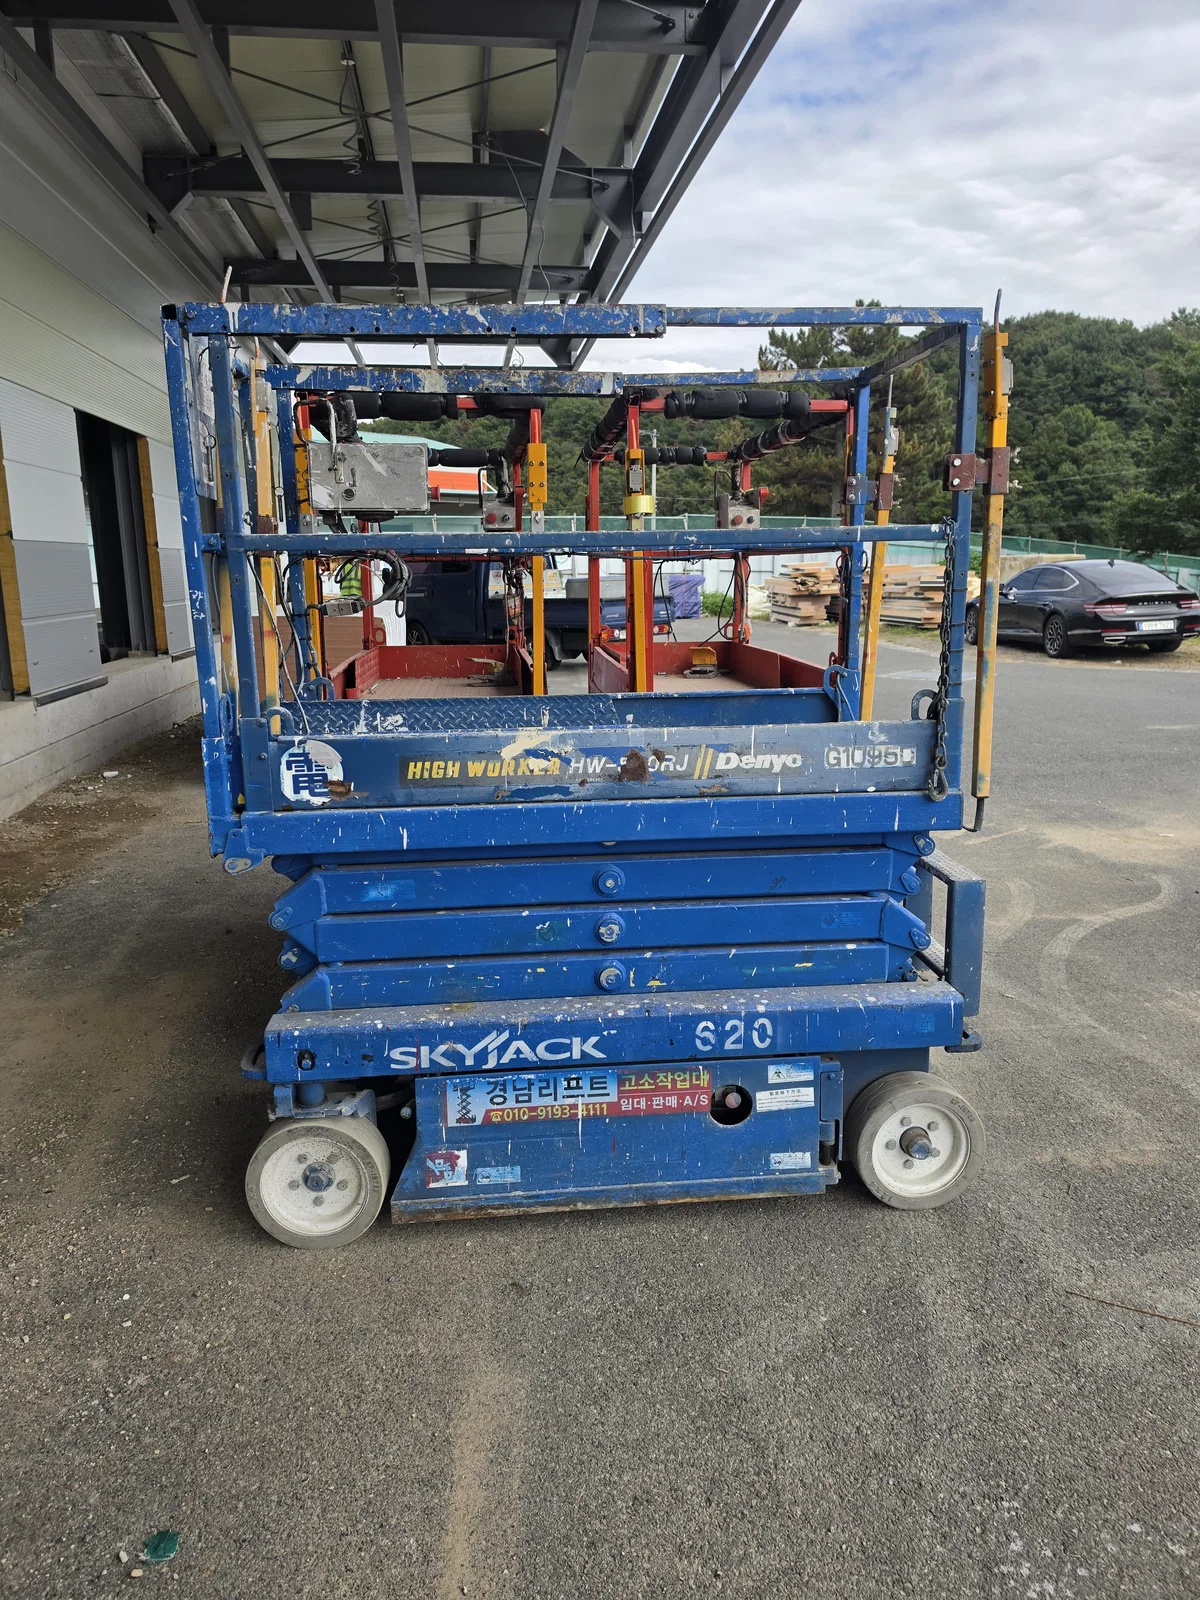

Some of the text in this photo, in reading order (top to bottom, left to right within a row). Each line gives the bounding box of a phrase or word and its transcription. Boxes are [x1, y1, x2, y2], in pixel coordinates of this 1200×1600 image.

[407, 761, 461, 779] HIGH
[568, 754, 689, 775] HW-50RJ
[715, 752, 803, 774] Denyo
[695, 1017, 773, 1052] 620
[389, 1029, 607, 1070] SKYJACK
[486, 1075, 611, 1106] 경남리프트
[619, 1069, 709, 1091] 고소작업대
[503, 1103, 608, 1122] 010-9193-4111
